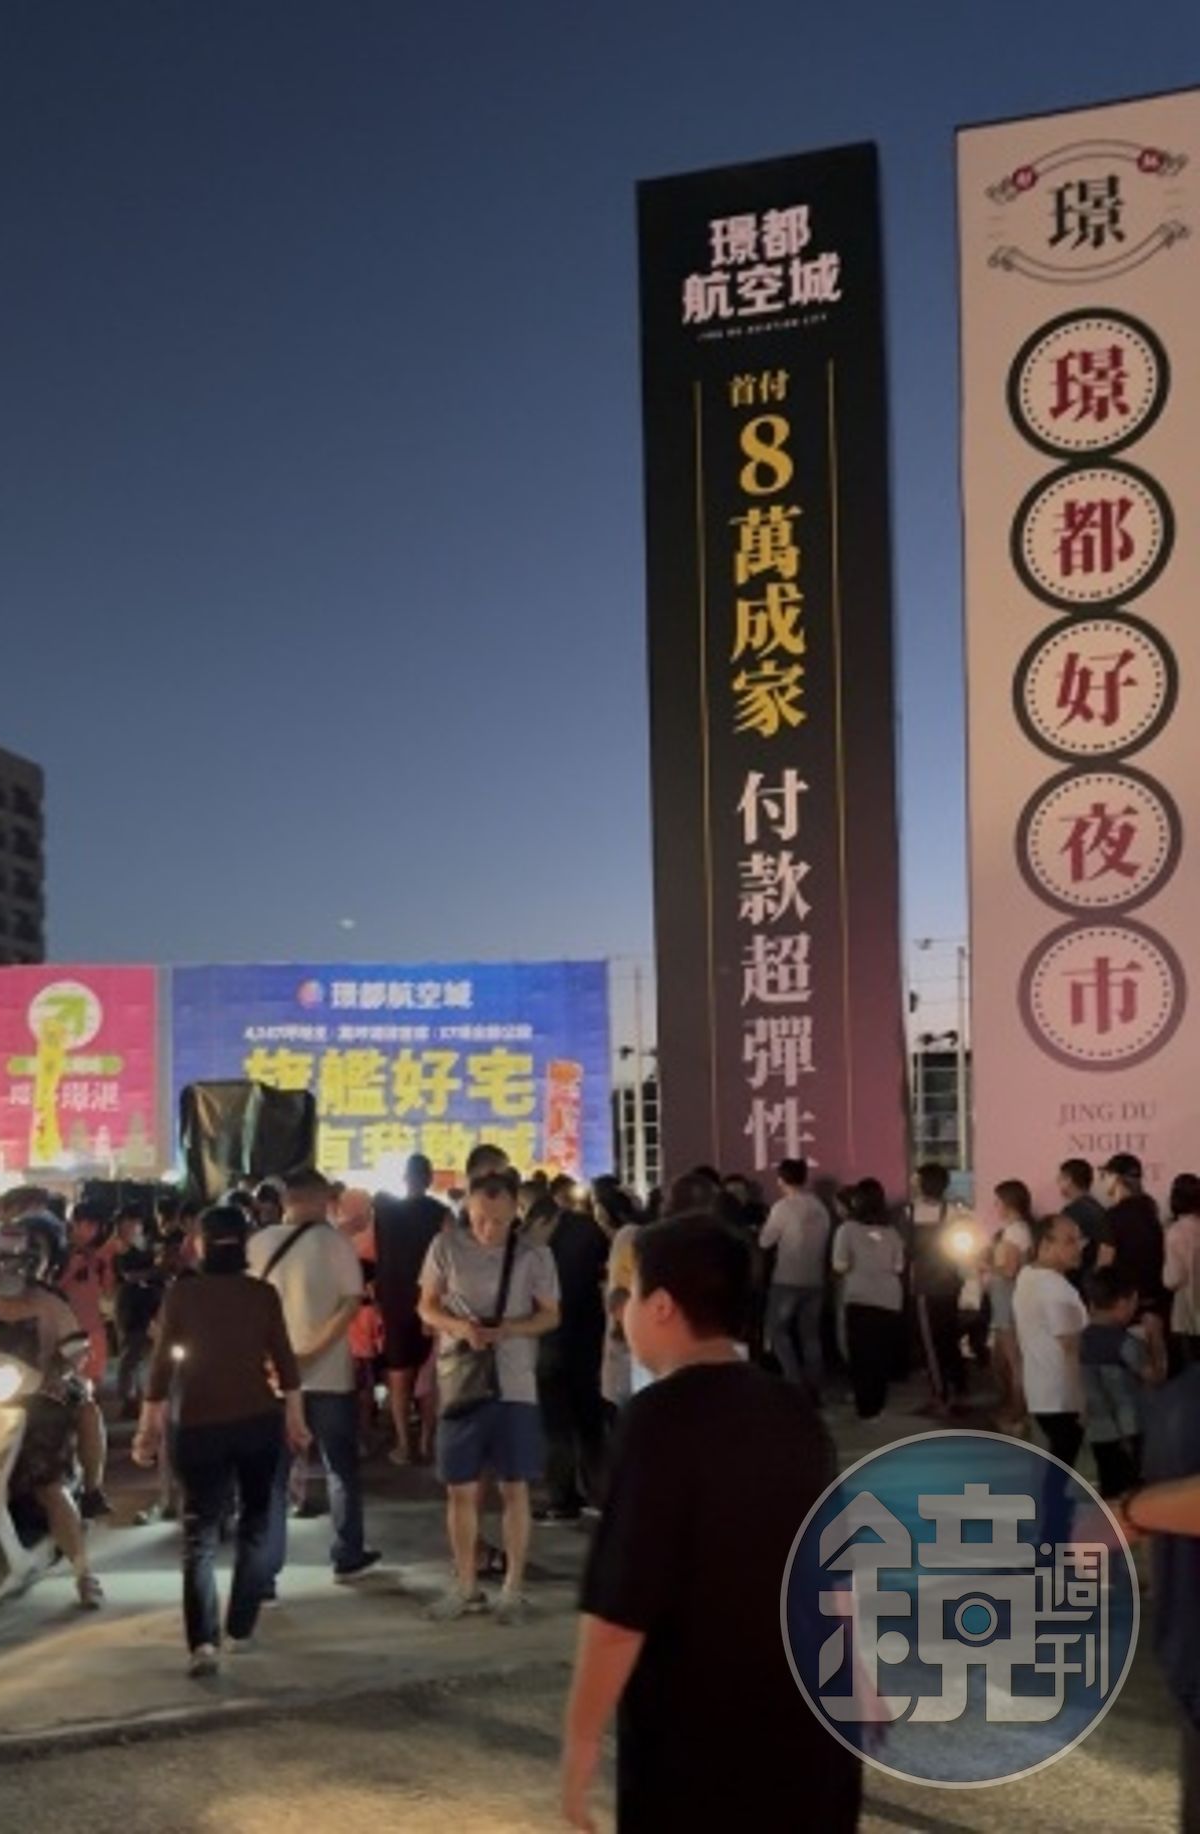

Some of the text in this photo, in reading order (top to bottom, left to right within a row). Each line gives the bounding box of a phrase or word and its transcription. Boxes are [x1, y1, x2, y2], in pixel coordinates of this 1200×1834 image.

[708, 203, 812, 268] 璟都
[681, 252, 842, 324] 航空城
[729, 369, 790, 408] 首付
[736, 768, 819, 1171] 付款超彈性
[1057, 1099, 1158, 1126] JING DU
[1068, 1132, 1150, 1153] NIGHT
